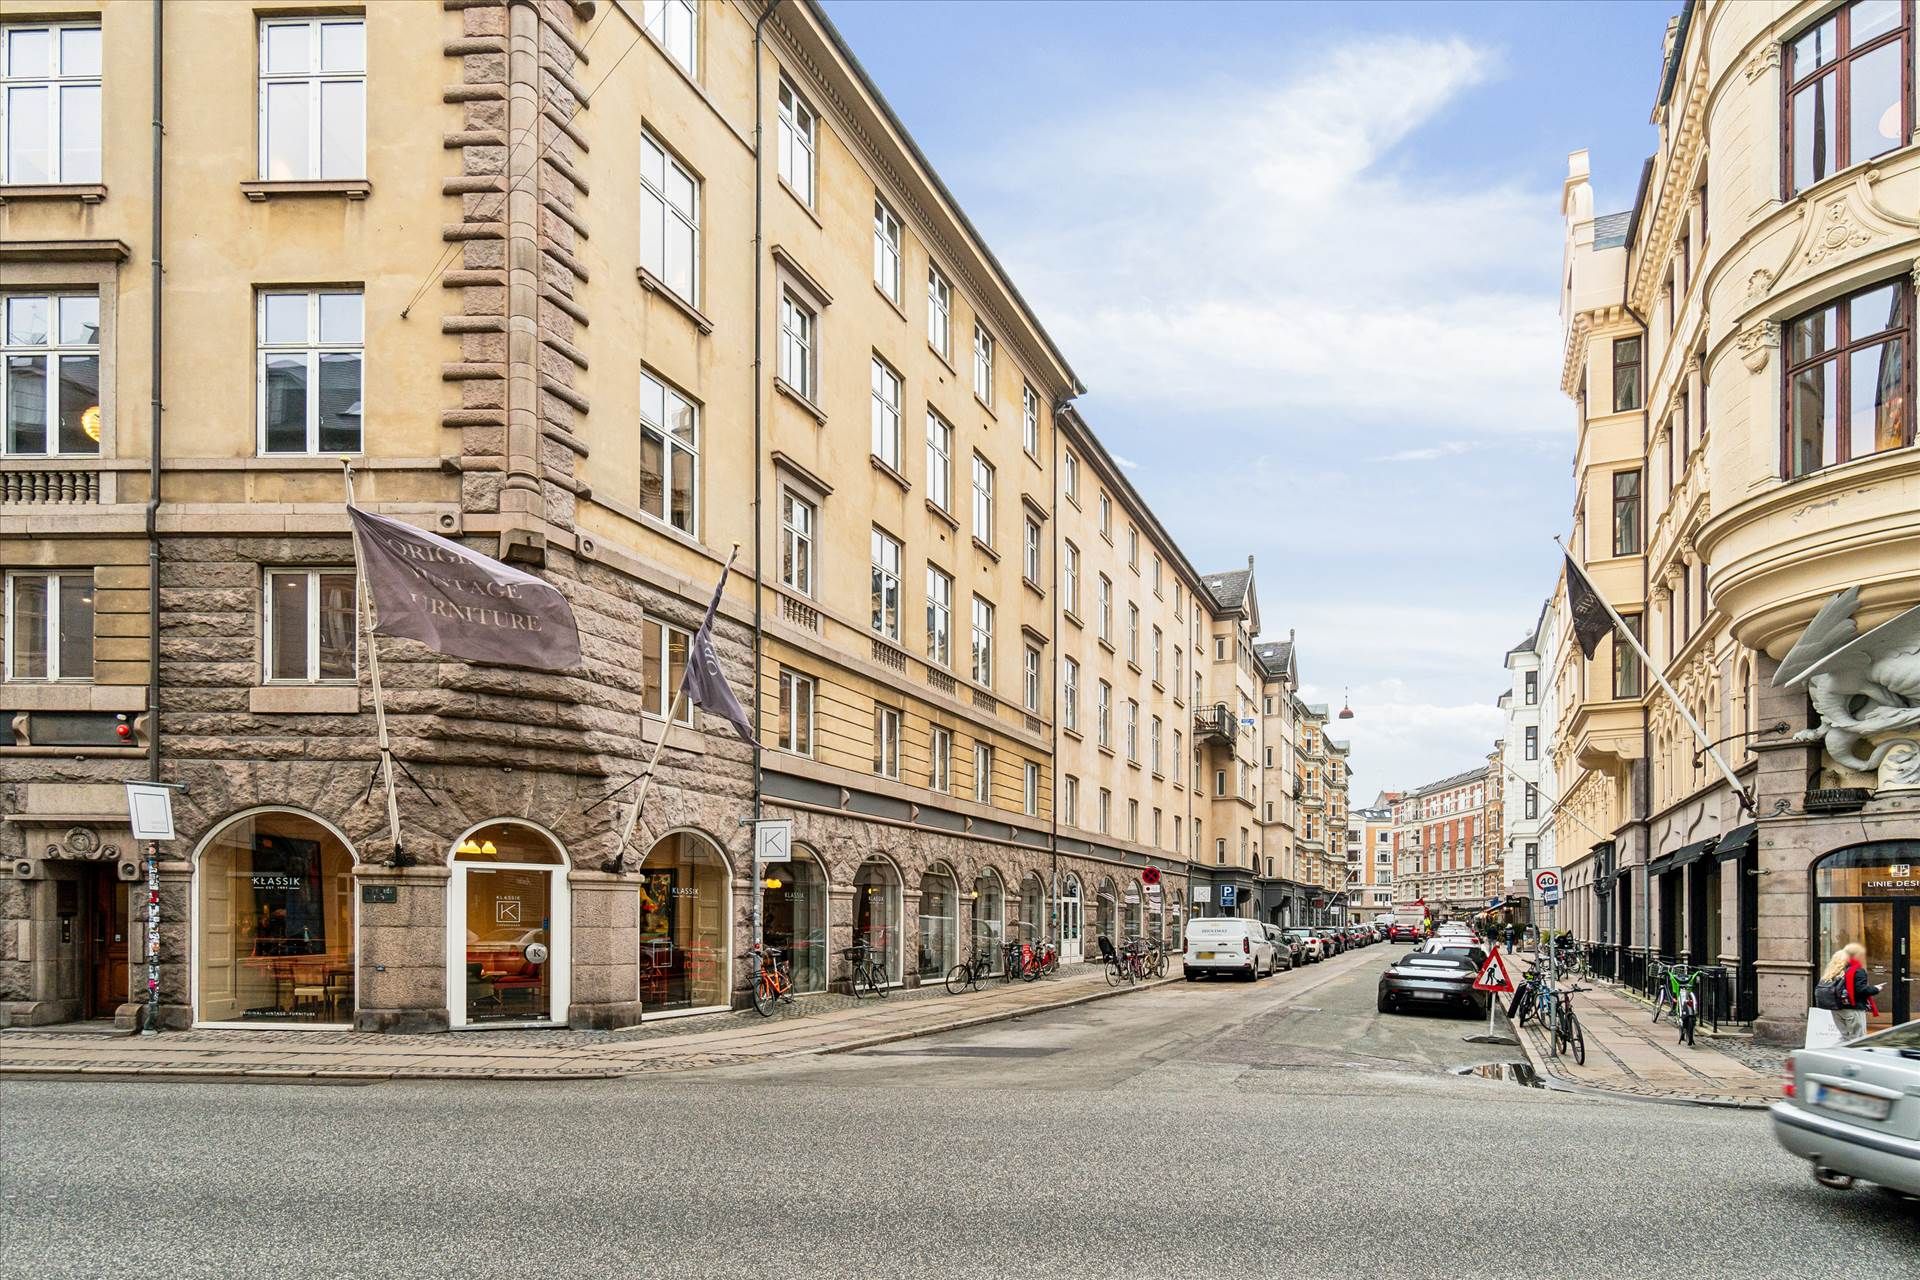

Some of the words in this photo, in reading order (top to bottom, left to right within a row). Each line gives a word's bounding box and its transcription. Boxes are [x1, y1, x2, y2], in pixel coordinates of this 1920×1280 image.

[409, 592, 542, 632] URNITURE
[764, 831, 783, 853] K
[252, 877, 300, 886] KLASSIK
[1540, 877, 1554, 885] 40
[1867, 880, 1893, 888] LINIE
[671, 887, 699, 895] KLASSIK
[1223, 886, 1232, 897] P
[500, 903, 517, 920] K
[533, 948, 541, 957] K
